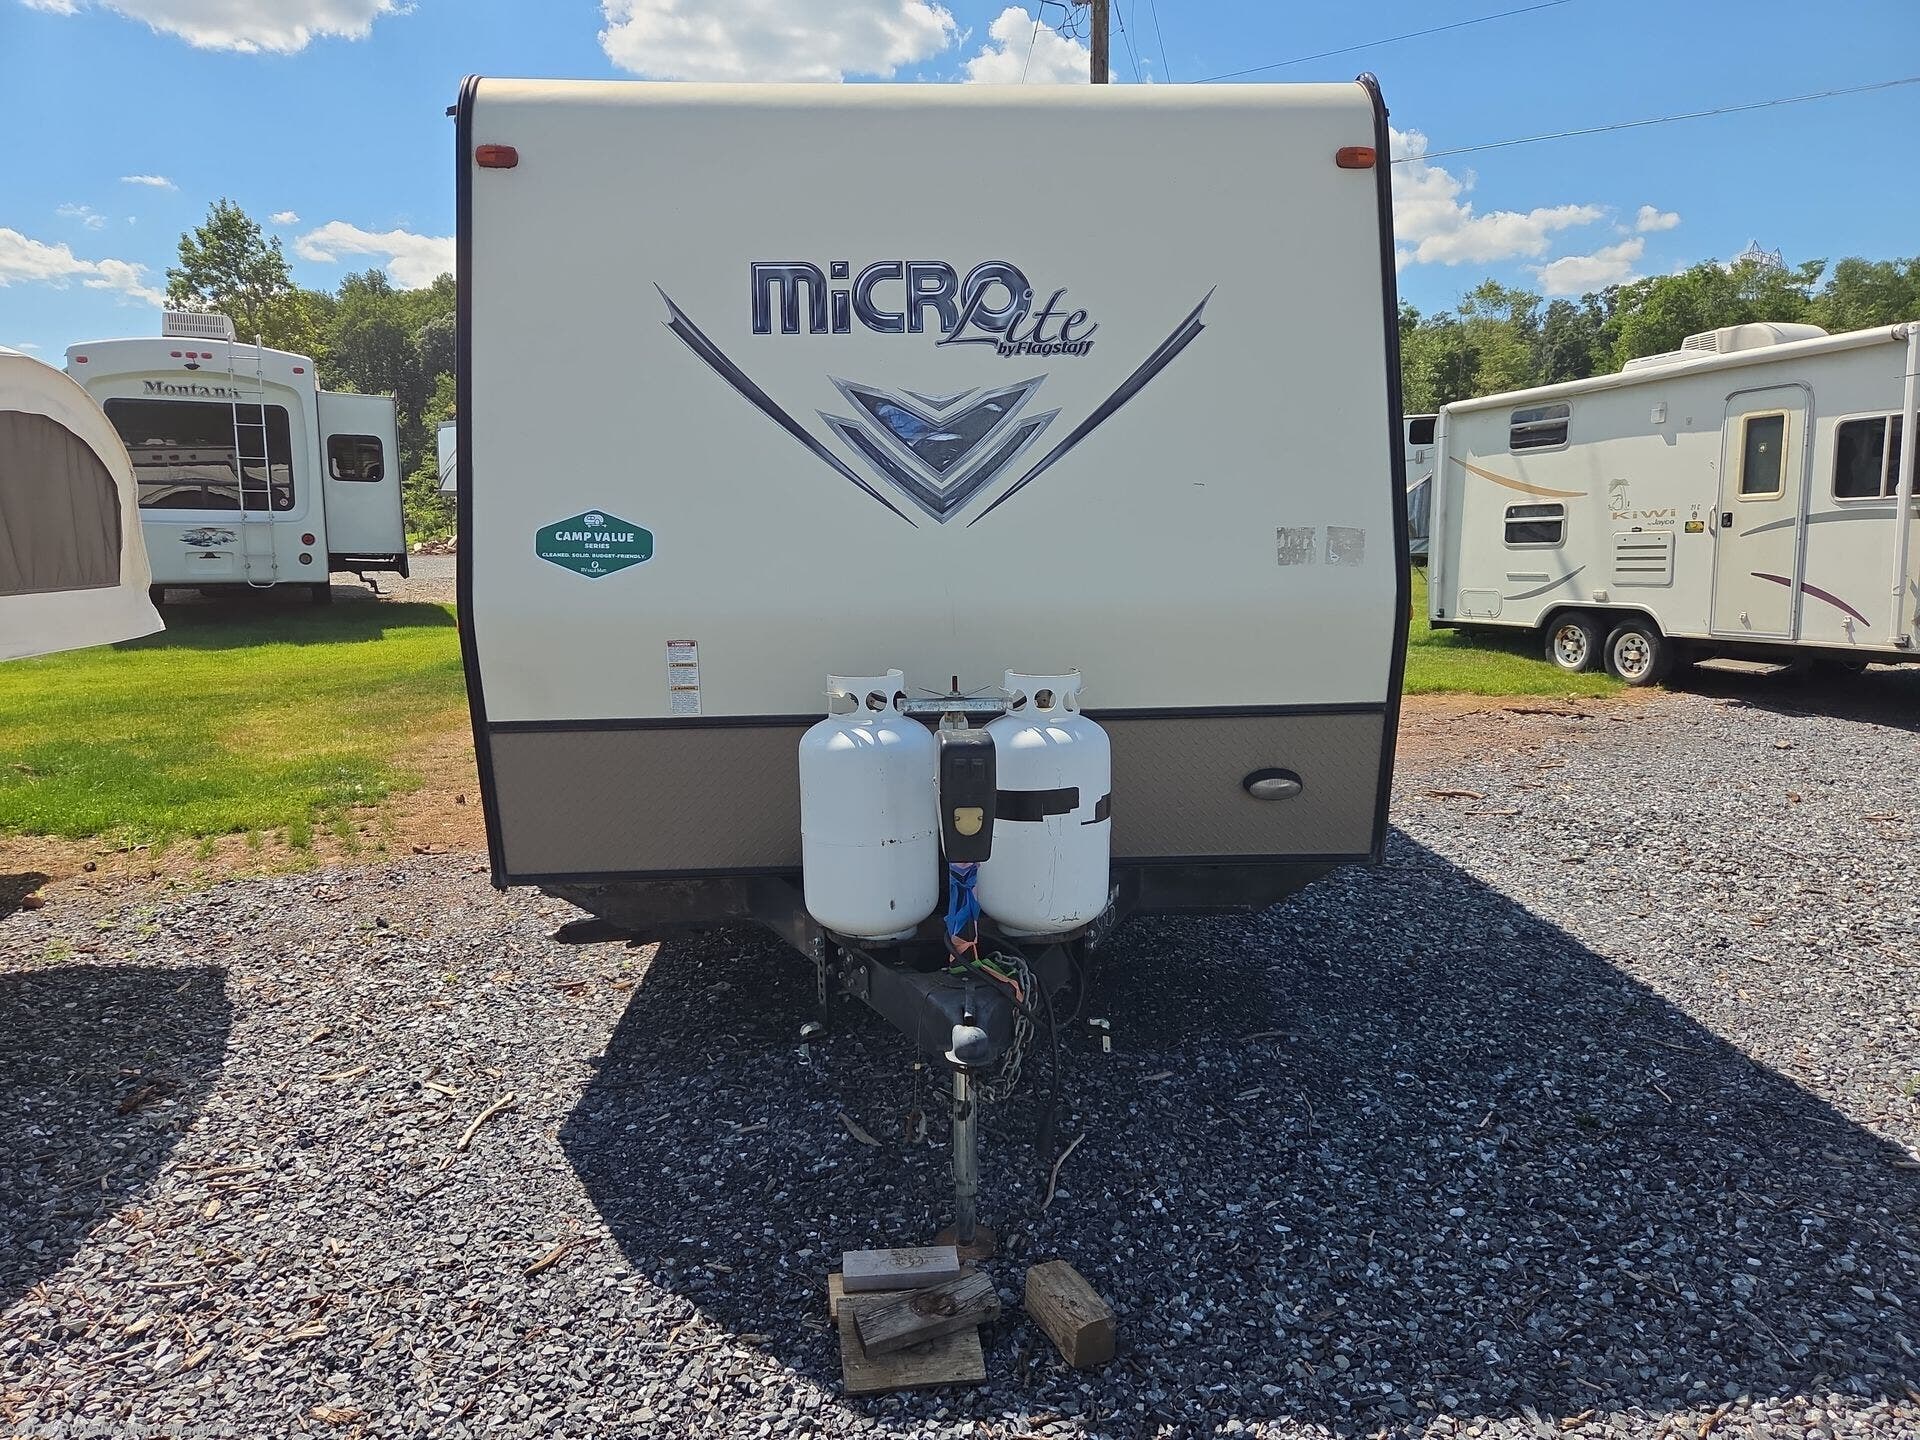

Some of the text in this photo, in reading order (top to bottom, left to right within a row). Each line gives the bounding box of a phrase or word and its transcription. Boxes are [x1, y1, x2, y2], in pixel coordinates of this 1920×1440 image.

[935, 277, 1098, 348] Lite
[997, 340, 1095, 358] by Flagstaff
[143, 380, 241, 399] Montana
[555, 531, 635, 542] CAMP VALUE
